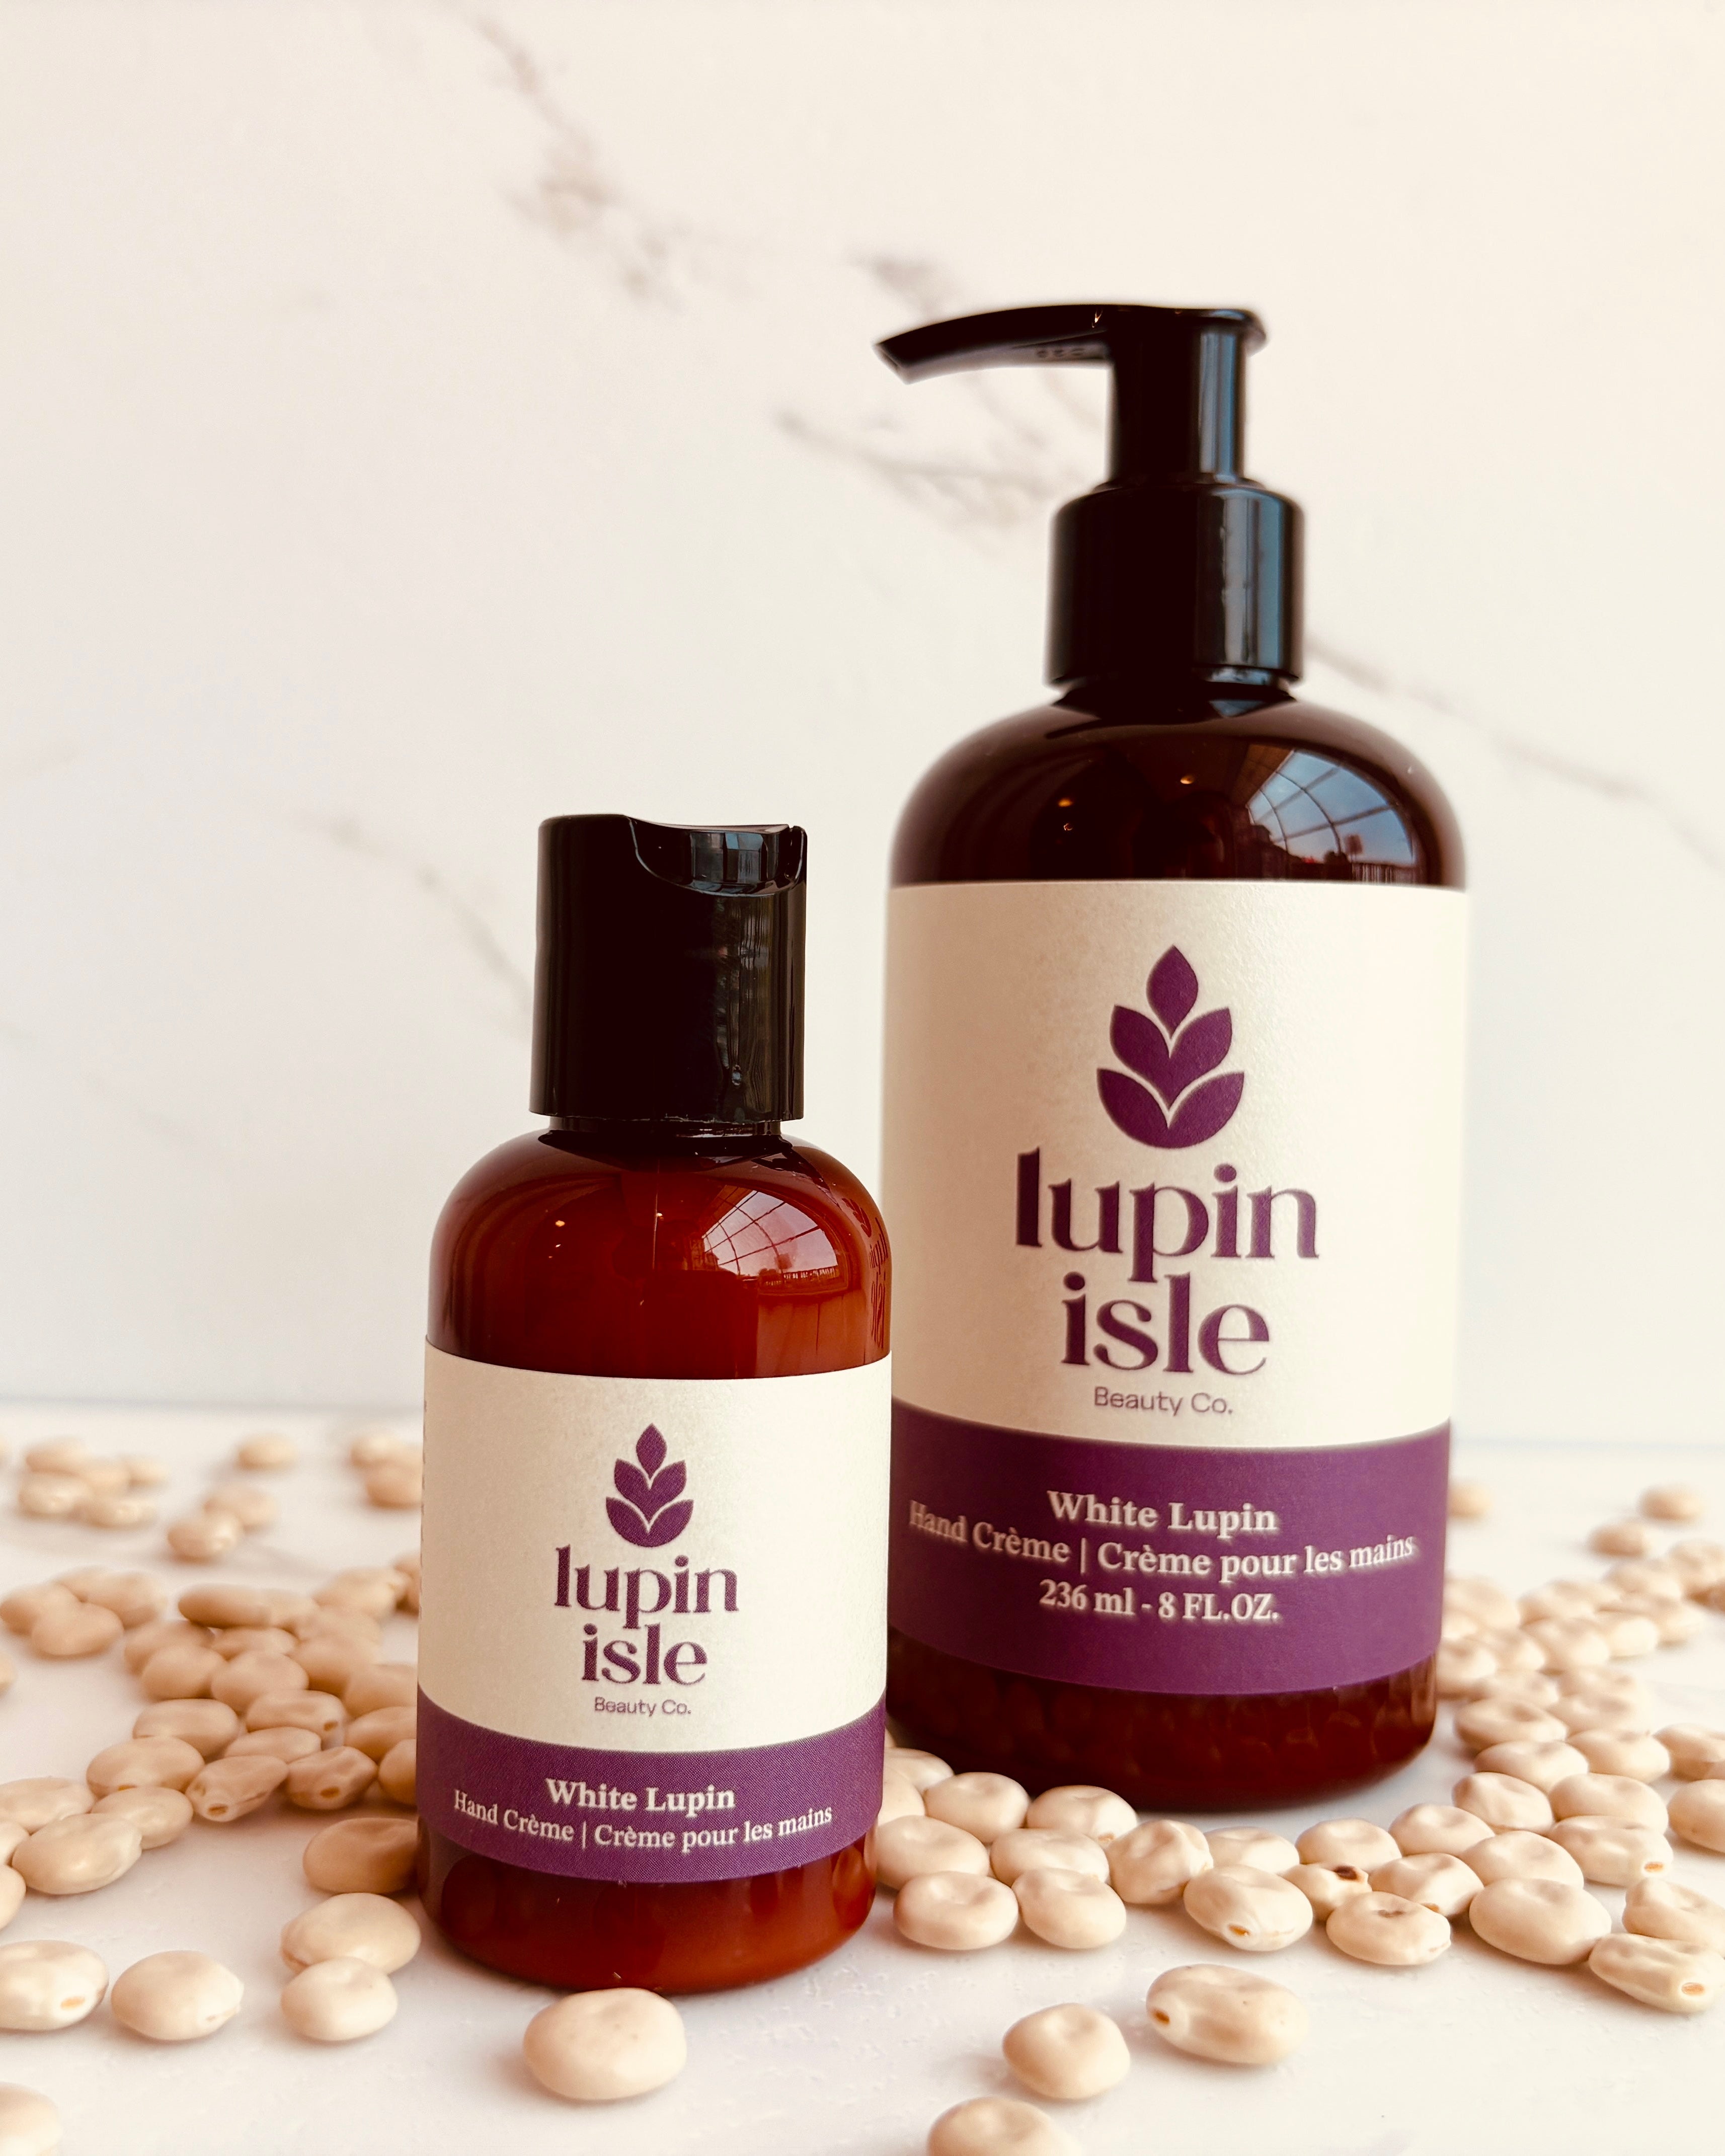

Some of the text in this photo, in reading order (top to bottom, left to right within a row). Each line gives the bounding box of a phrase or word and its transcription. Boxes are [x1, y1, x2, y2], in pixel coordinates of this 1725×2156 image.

[1015, 1146, 1319, 1283] lupin
[1061, 1271, 1270, 1375] isle
[1094, 1386, 1233, 1416] Beauty Co.
[910, 1500, 967, 1543] Hand
[973, 1521, 1070, 1564] Crème
[1099, 1543, 1212, 1578] Crème
[1220, 1555, 1297, 1584] pour
[1305, 1546, 1343, 1573] les
[1350, 1535, 1416, 1569] mains
[1048, 1491, 1279, 1541] White Lupin
[554, 1544, 739, 1630] lupin
[1040, 1579, 1087, 1610] 236
[1094, 1588, 1134, 1616] ml
[1159, 1592, 1175, 1619] 8
[1183, 1593, 1279, 1621] FL.OZ.
[582, 1623, 708, 1686] isle
[594, 1697, 691, 1717] Beauty Co.
[454, 1790, 498, 1825] Hand
[504, 1810, 574, 1842] Crème
[595, 1825, 675, 1849] Crème
[682, 1828, 739, 1854] pour
[744, 1821, 772, 1842] les
[778, 1807, 832, 1836] mains
[546, 1779, 735, 1818] White Lupin
